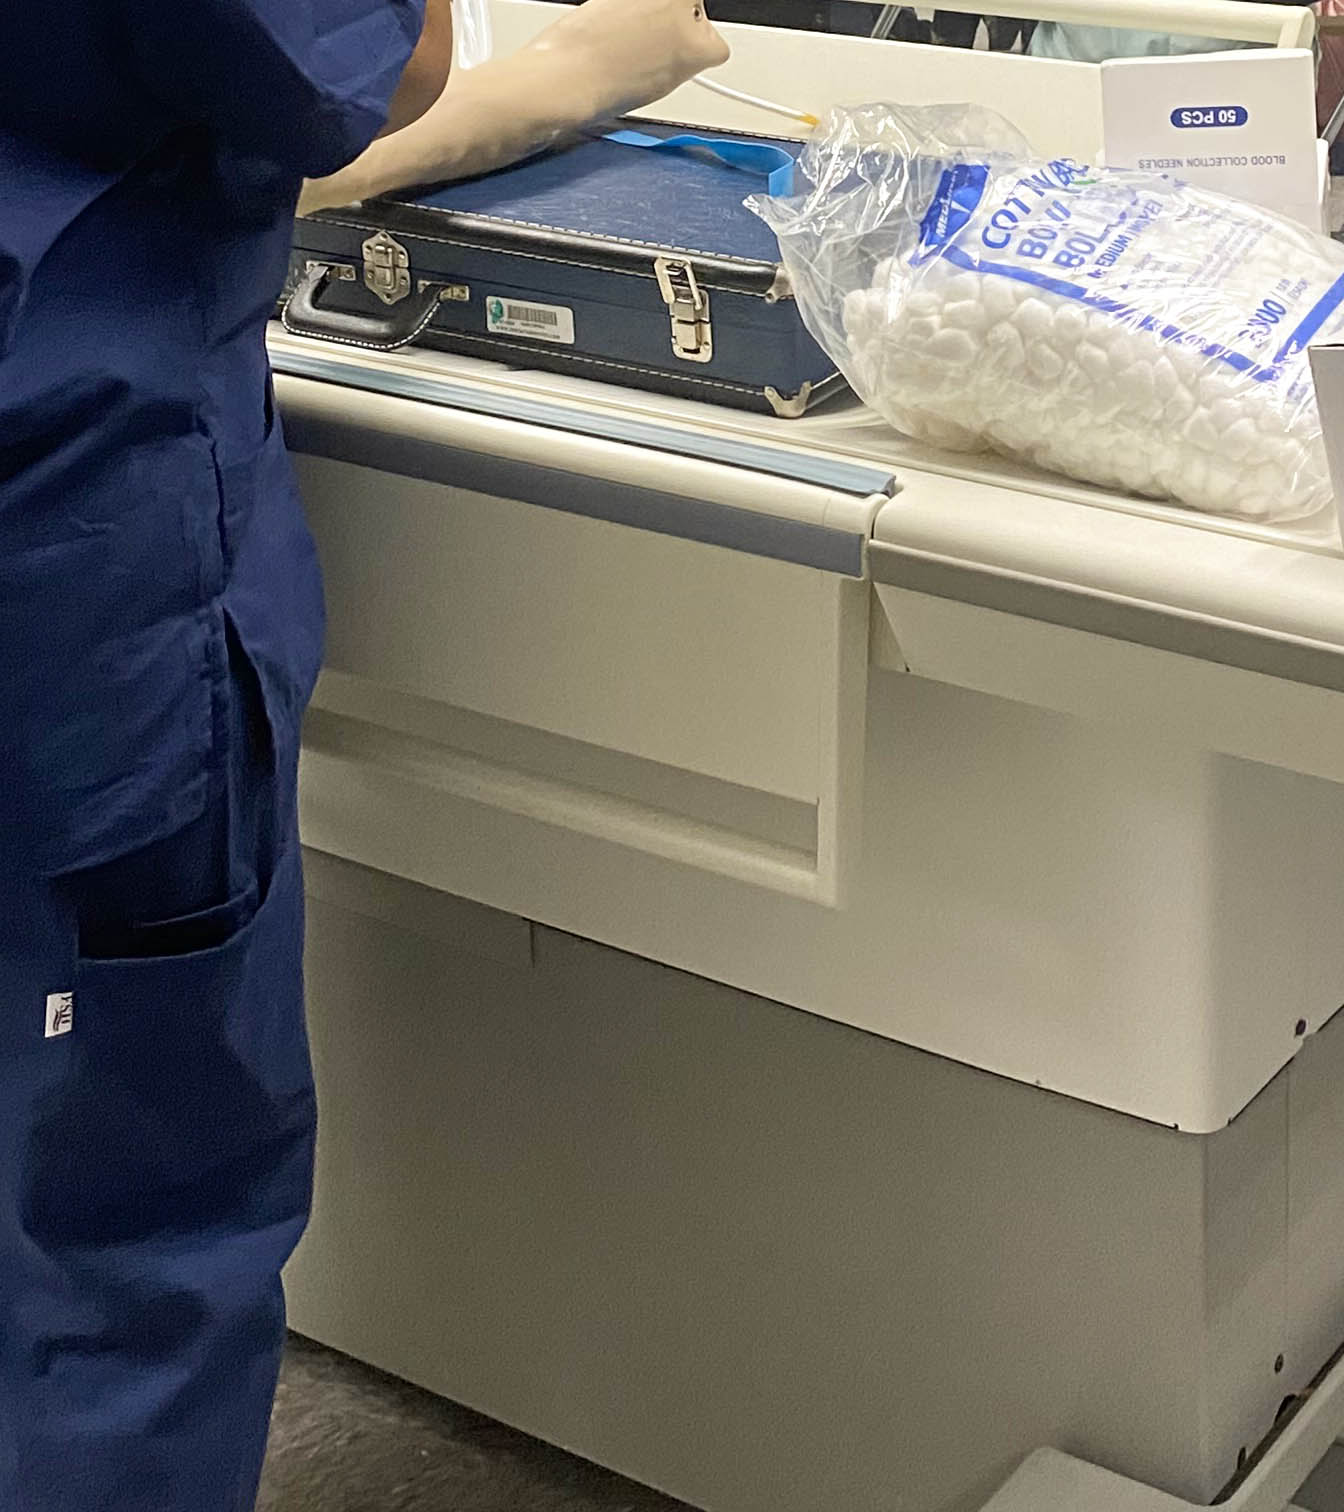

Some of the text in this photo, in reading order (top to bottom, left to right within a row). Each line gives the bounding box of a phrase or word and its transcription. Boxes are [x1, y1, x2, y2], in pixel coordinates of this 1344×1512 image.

[1181, 109, 1237, 125] 50 PCS
[1138, 155, 1286, 169] BLOOD COLLECTION NEEDLES
